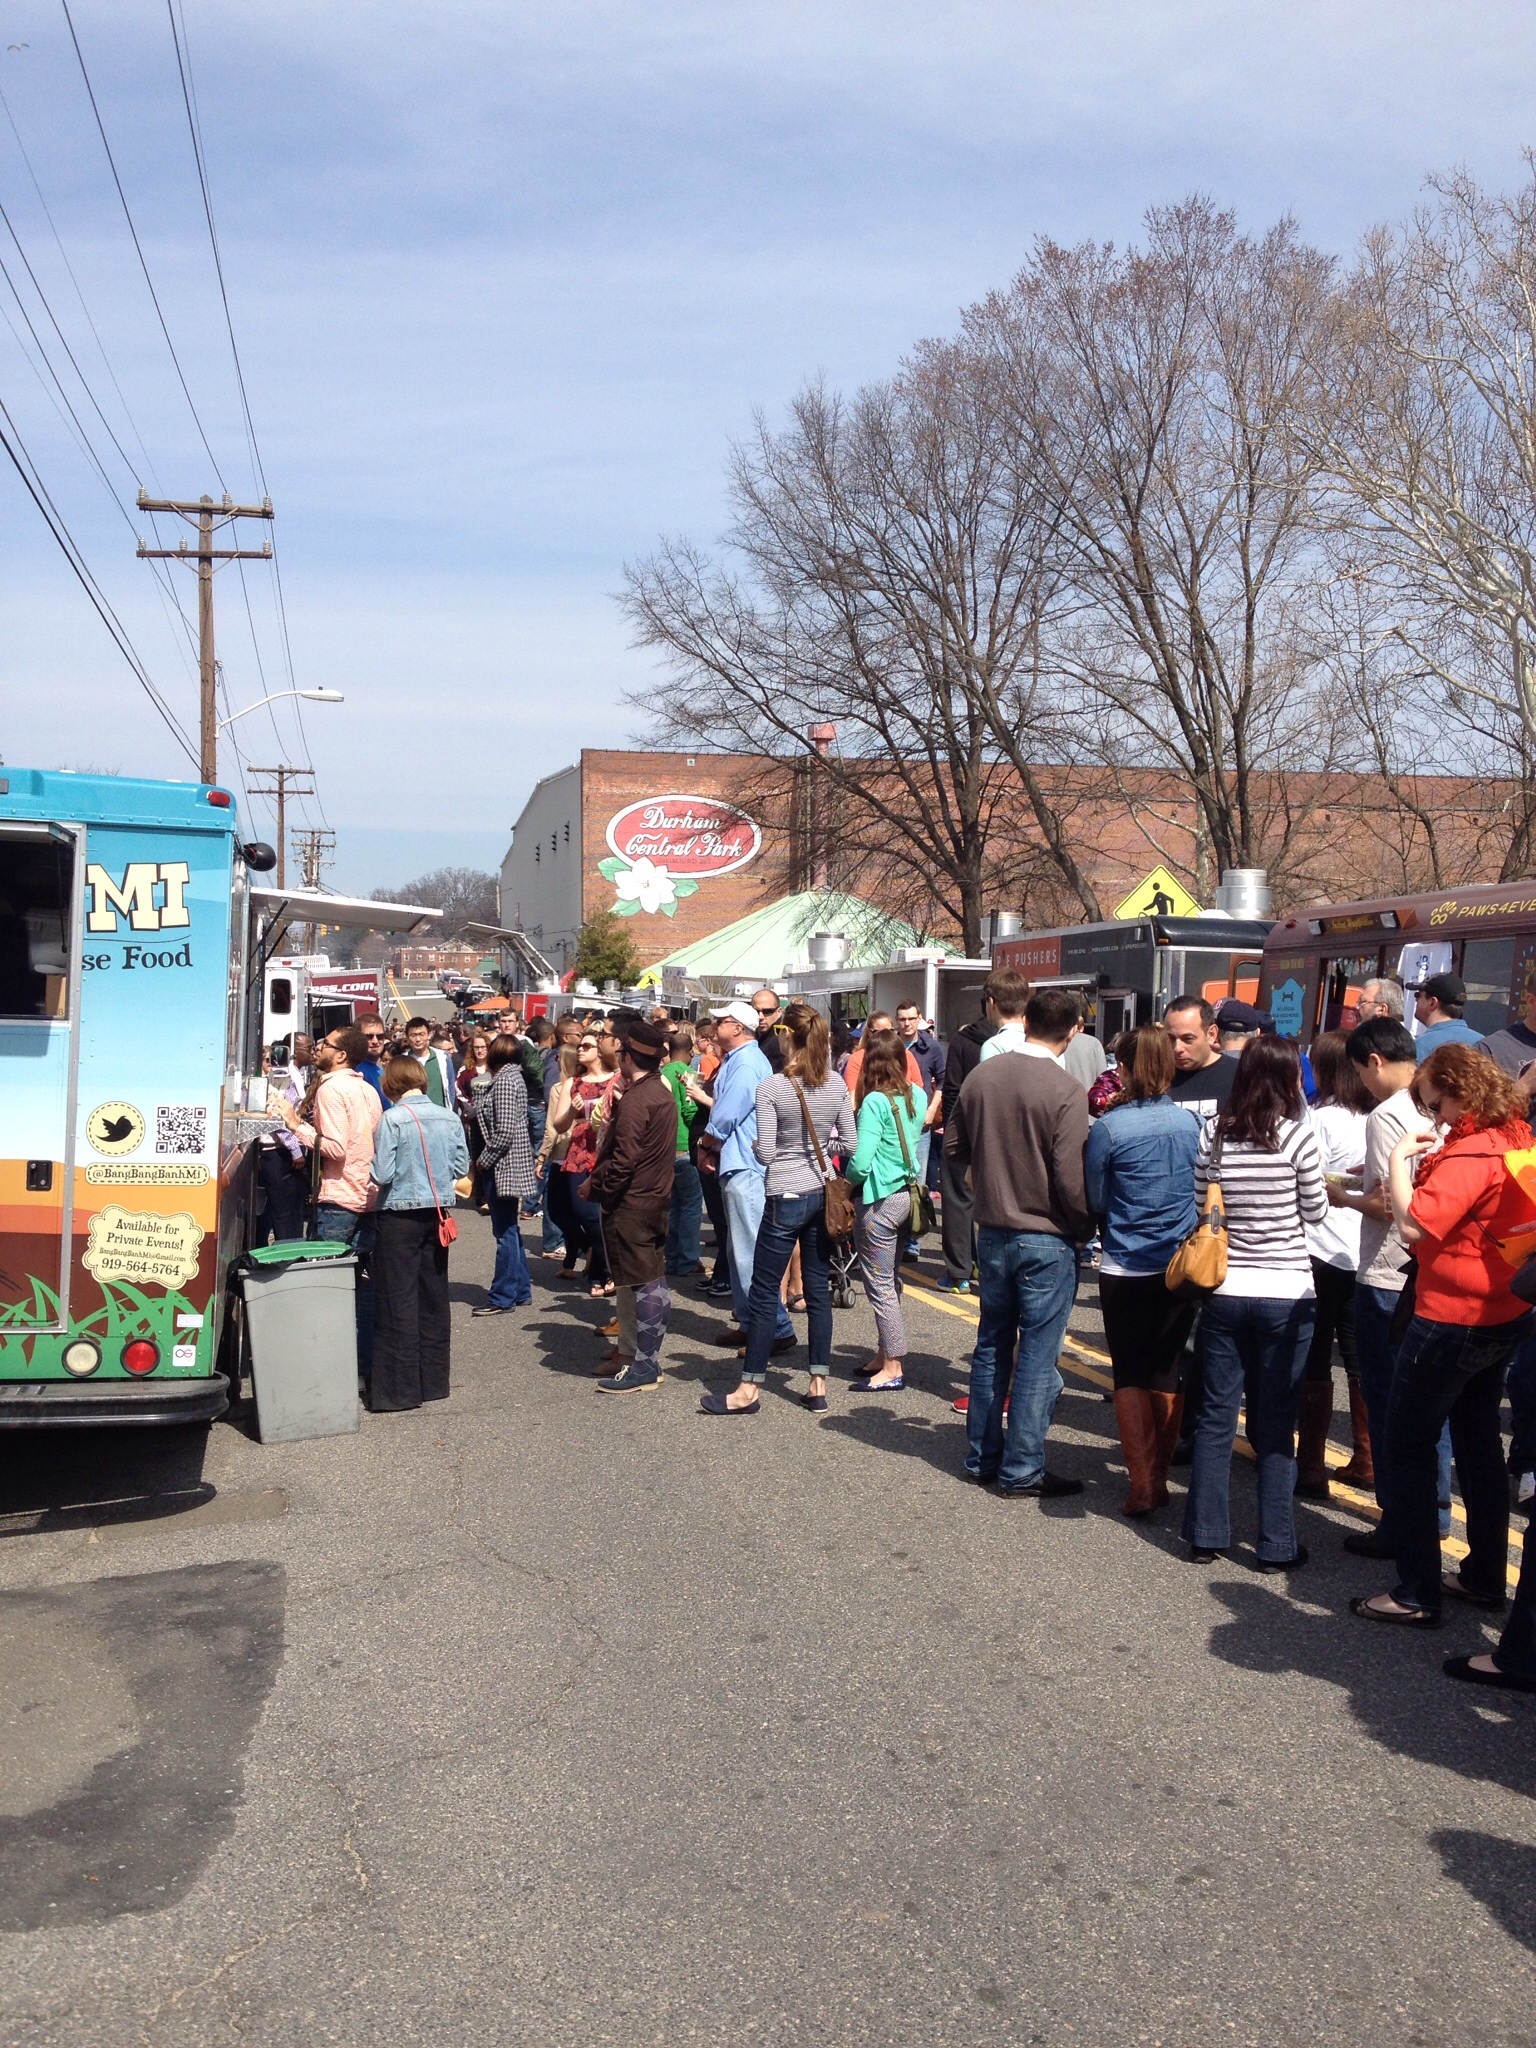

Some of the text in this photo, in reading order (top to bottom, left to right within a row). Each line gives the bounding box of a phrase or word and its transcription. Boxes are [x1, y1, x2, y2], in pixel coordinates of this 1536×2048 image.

[640, 806, 721, 829] Durham
[626, 832, 742, 857] Central Park
[85, 861, 190, 933] MI
[82, 943, 194, 971] se Food
[1015, 949, 1057, 966] PUSHERS
[92, 1168, 201, 1180] @BangBangBanhMi
[115, 1218, 180, 1235] Available for
[106, 1232, 184, 1251] Private Events!
[101, 1257, 180, 1276] 919-564-5764
